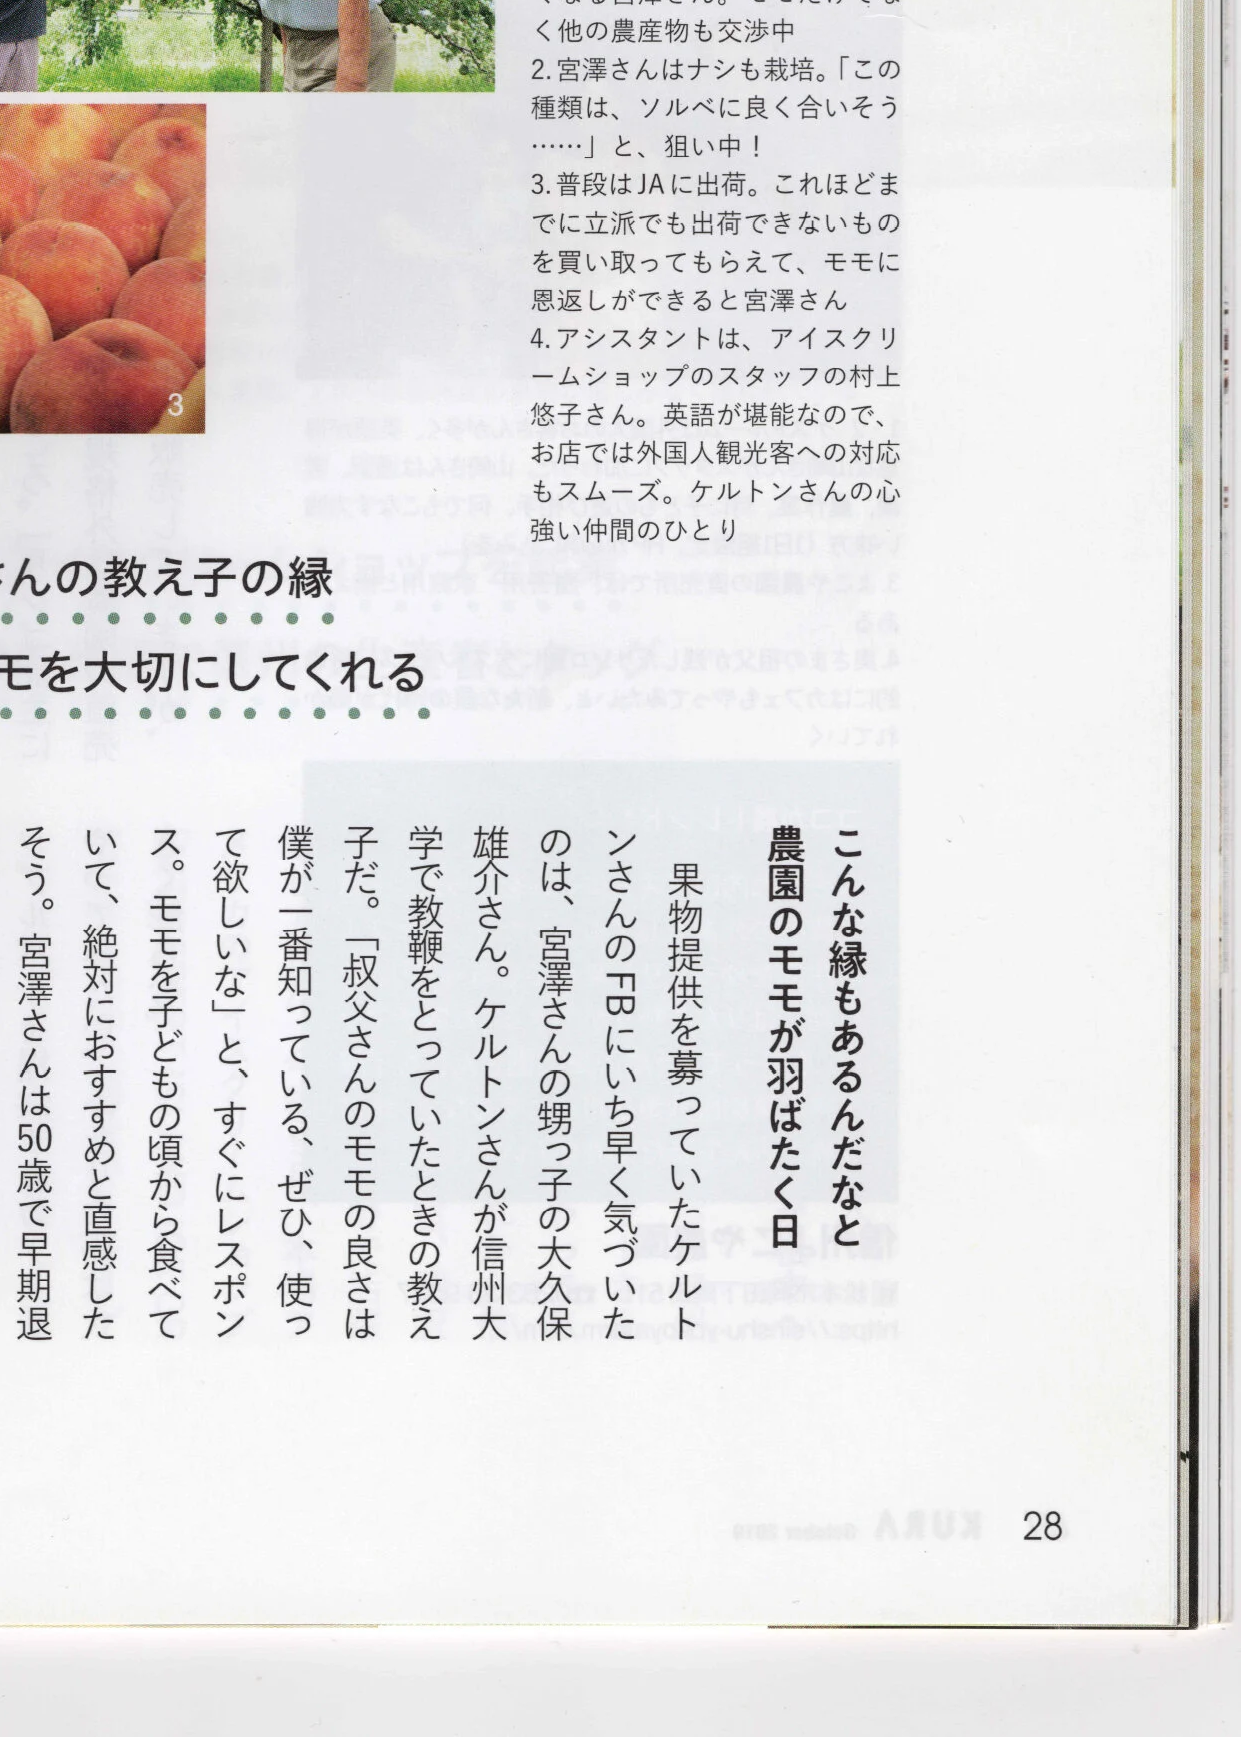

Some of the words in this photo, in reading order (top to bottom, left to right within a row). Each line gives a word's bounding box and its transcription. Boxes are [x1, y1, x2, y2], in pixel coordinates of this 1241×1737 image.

[531, 94, 897, 121] 種類は、ソルベに良く合いそう
[532, 210, 900, 236] でに立派でも出荷できないもの
[536, 17, 794, 44] く他の農産物も交渉中
[168, 393, 184, 416] 3
[530, 402, 884, 428] 悠子さん。英語が堪能なので、
[531, 288, 847, 313] 恩返しができると宮澤さん
[531, 439, 900, 466] お店では外国人観光客への対応
[532, 363, 901, 389] ームショップのスタッフの村上
[533, 249, 900, 275] を買い取ってもらえて、モモに
[530, 517, 735, 543] 強い仲間のひとり
[533, 479, 901, 505] もスムーズ。ケルトンさんの心
[16, 826, 54, 1341] そう。宮澤さんは50歳で早期退
[82, 829, 119, 1340] いて、絶対におすすめと直感した
[146, 829, 185, 1339] ス。モモを子どもの頃から食べて
[211, 828, 249, 1338] て欲しいな」と、すぐにレスポン
[276, 825, 314, 1336] 僕が一番知っている、ぜひ、使っ
[342, 826, 380, 1340] 子だ。「叔父さんのモモの良さは
[406, 825, 444, 1340] 学で教鞭をとっていたときの教え
[471, 825, 509, 1341] 雄介さん。ケルトンさんが信州大
[536, 829, 574, 1342] のは、宮澤さんの甥っ子の大久保
[602, 830, 639, 1340] ンさんのFBにいち早く気づいた
[667, 863, 704, 1340] 果物提供を募っていたケルト
[766, 825, 806, 1249] 農園のモモが羽ばたく日
[828, 830, 867, 1247] こんな縁もあるんだなと
[1023, 1510, 1063, 1541] 28
